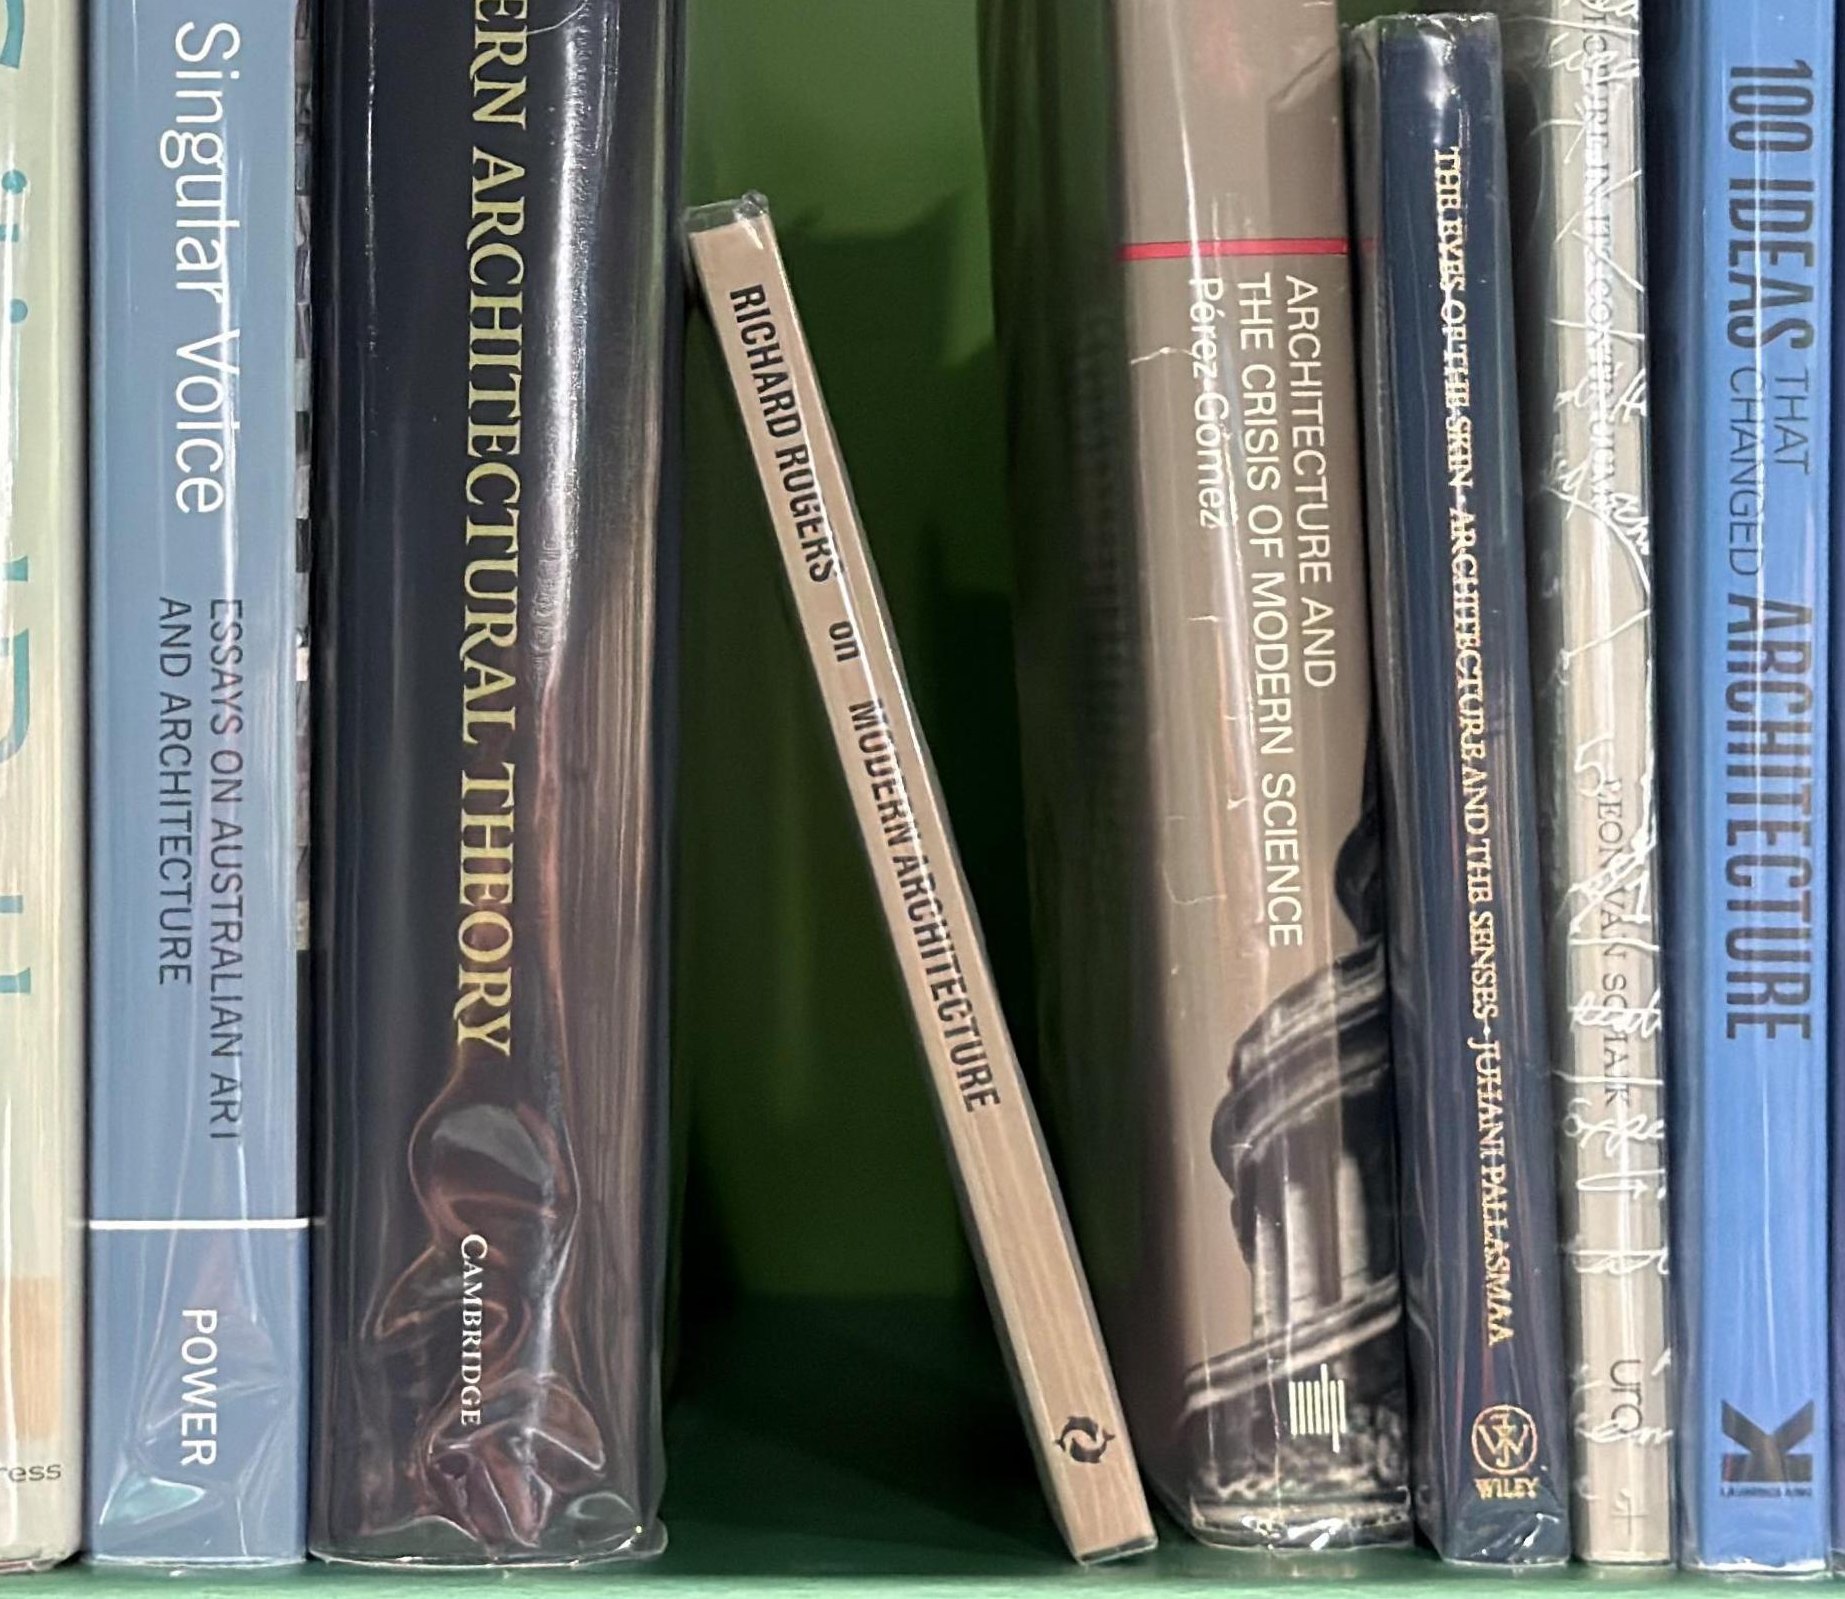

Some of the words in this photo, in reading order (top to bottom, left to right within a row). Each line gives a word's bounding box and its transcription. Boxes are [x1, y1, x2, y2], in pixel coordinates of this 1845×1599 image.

[159, 19, 242, 304] Singular
[1727, 58, 1815, 153] 100
[1434, 147, 1462, 210] THE
[1237, 271, 1274, 352] THE
[1436, 219, 1465, 292] EYES
[1439, 300, 1467, 339] OF
[1726, 177, 1815, 350] IDEAS
[175, 327, 241, 513] Voice
[1188, 277, 1233, 529] Pérez-Gómez
[1241, 362, 1283, 492] CRISIS
[1284, 274, 1332, 584] ARCHITECTURE
[1441, 340, 1470, 406] THE
[1774, 366, 1810, 476] THAT
[459, 145, 527, 745] ARCHITECTURAL
[1445, 415, 1473, 488] SKIN
[1727, 366, 1764, 578] CHANGED
[1247, 504, 1286, 561] OF
[159, 595, 193, 678] AND
[209, 598, 243, 735] ESSAYS
[730, 284, 804, 439] RICHARD
[772, 447, 844, 585] ROGERS
[828, 619, 862, 663] on
[847, 698, 925, 848] MODERN
[892, 851, 1001, 1113] ARCHITECTURE
[1250, 571, 1294, 754] MODERN
[1300, 596, 1337, 688] AND
[1448, 506, 1485, 763] ARCHITECTURE
[158, 690, 193, 986] ARCHITECTURE
[209, 748, 243, 804] ON
[1460, 766, 1489, 835] AND
[1725, 592, 1815, 1041] ARCHITECTURE
[453, 761, 515, 1056] THEORY
[1259, 771, 1303, 948] SCIENCE
[1466, 837, 1493, 904] THE
[209, 817, 244, 1057] AUSTRALIAN
[1468, 910, 1498, 1021] SENSES
[1467, 1037, 1506, 1159] JUHANI
[1480, 1163, 1515, 1348] PALLASMAA
[179, 1308, 218, 1466] POWER
[460, 1232, 488, 1426] CAMBRIDGE
[1474, 1477, 1539, 1499] WILEY
